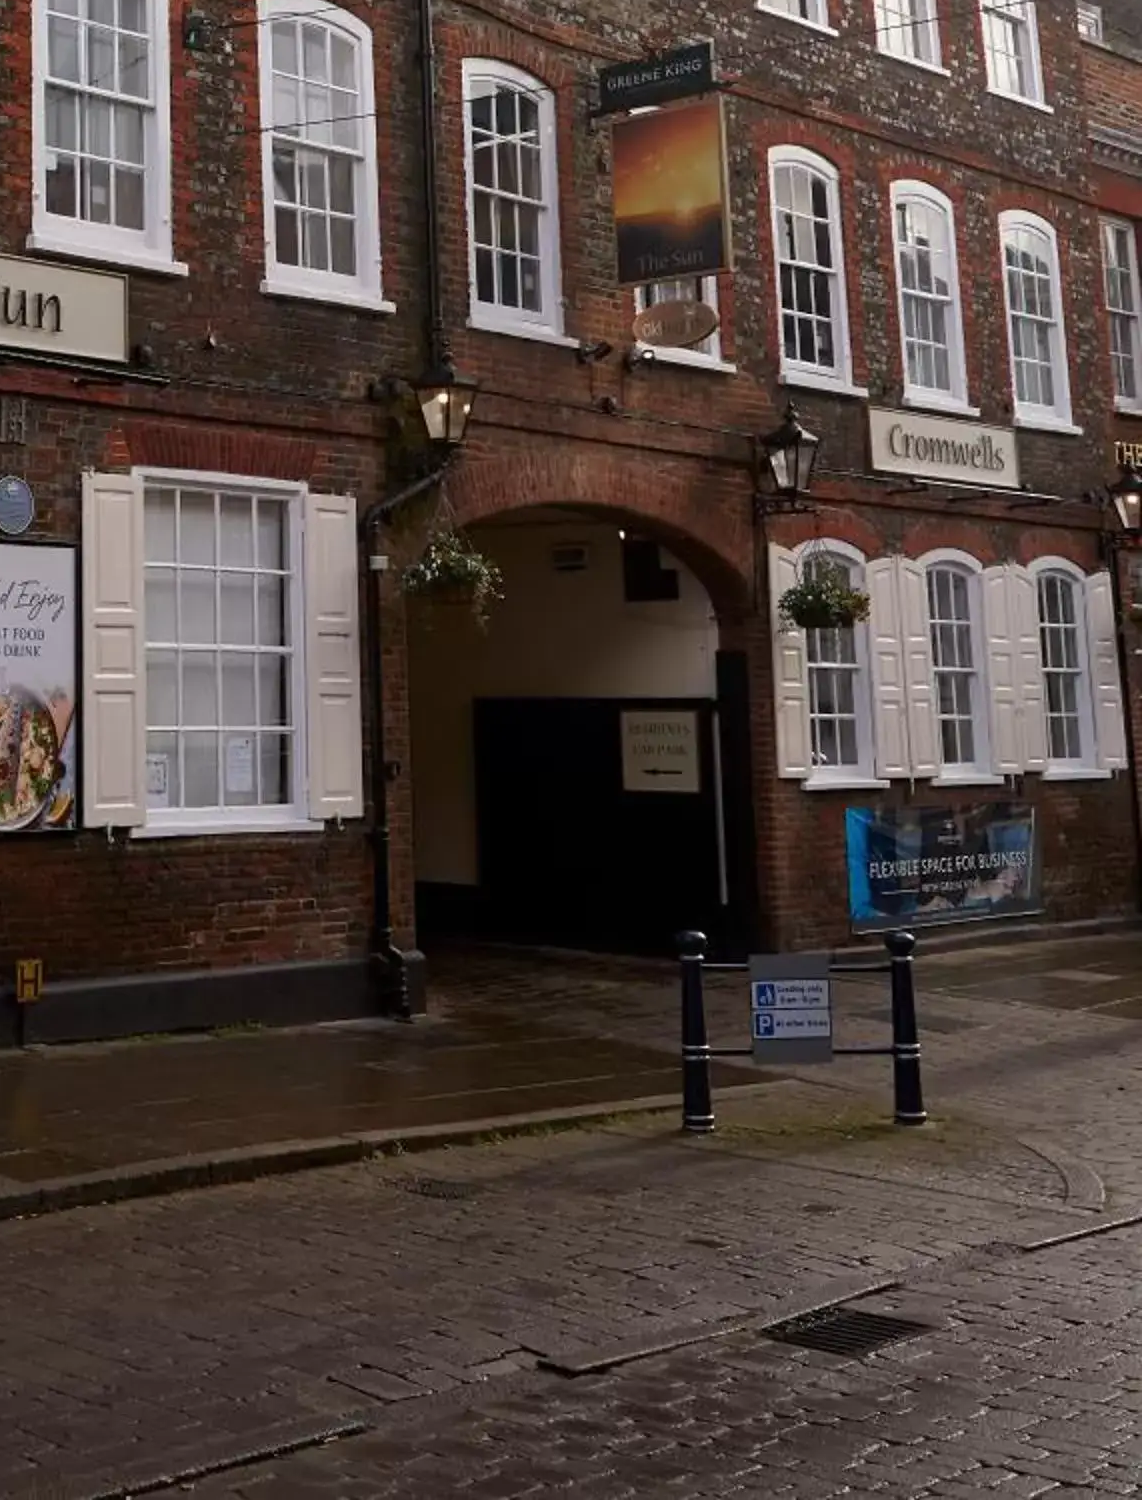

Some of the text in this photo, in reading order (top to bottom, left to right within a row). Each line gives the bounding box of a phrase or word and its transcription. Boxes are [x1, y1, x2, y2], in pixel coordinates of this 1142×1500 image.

[607, 68, 663, 90] GREENE
[665, 59, 702, 77] KING
[636, 248, 703, 275] The Sun
[889, 424, 1005, 471] Cromwells
[1114, 441, 1142, 468] THE
[14, 580, 65, 622] Enjoy
[13, 627, 45, 641] FOOD
[3, 644, 42, 657] DRINK
[869, 851, 1026, 879] FLEXIBLE SPACE FOR BUSINESS
[20, 964, 38, 997] H
[759, 1015, 771, 1034] P
